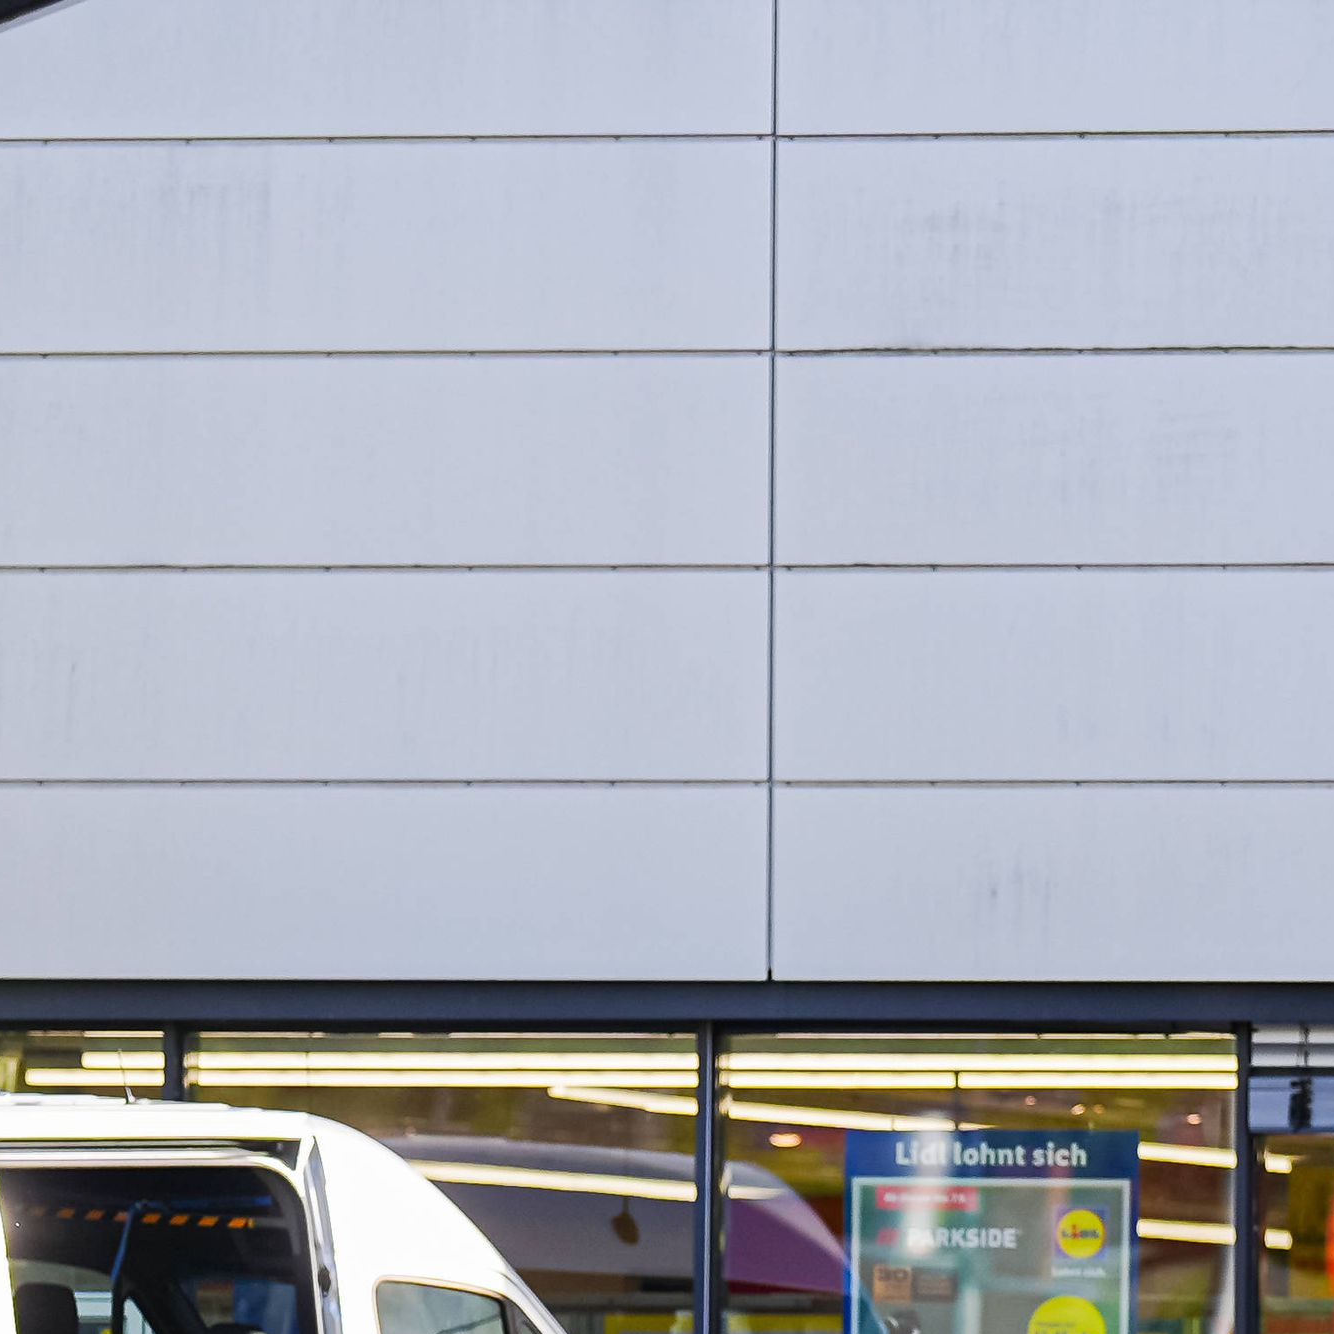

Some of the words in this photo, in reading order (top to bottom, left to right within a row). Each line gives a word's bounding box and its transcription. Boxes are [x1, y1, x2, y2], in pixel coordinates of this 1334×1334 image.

[895, 1142, 947, 1166] Lidl
[953, 1142, 1026, 1166] lohnt
[1032, 1142, 1087, 1167] sich
[906, 1227, 1017, 1249] PARKSIDE
